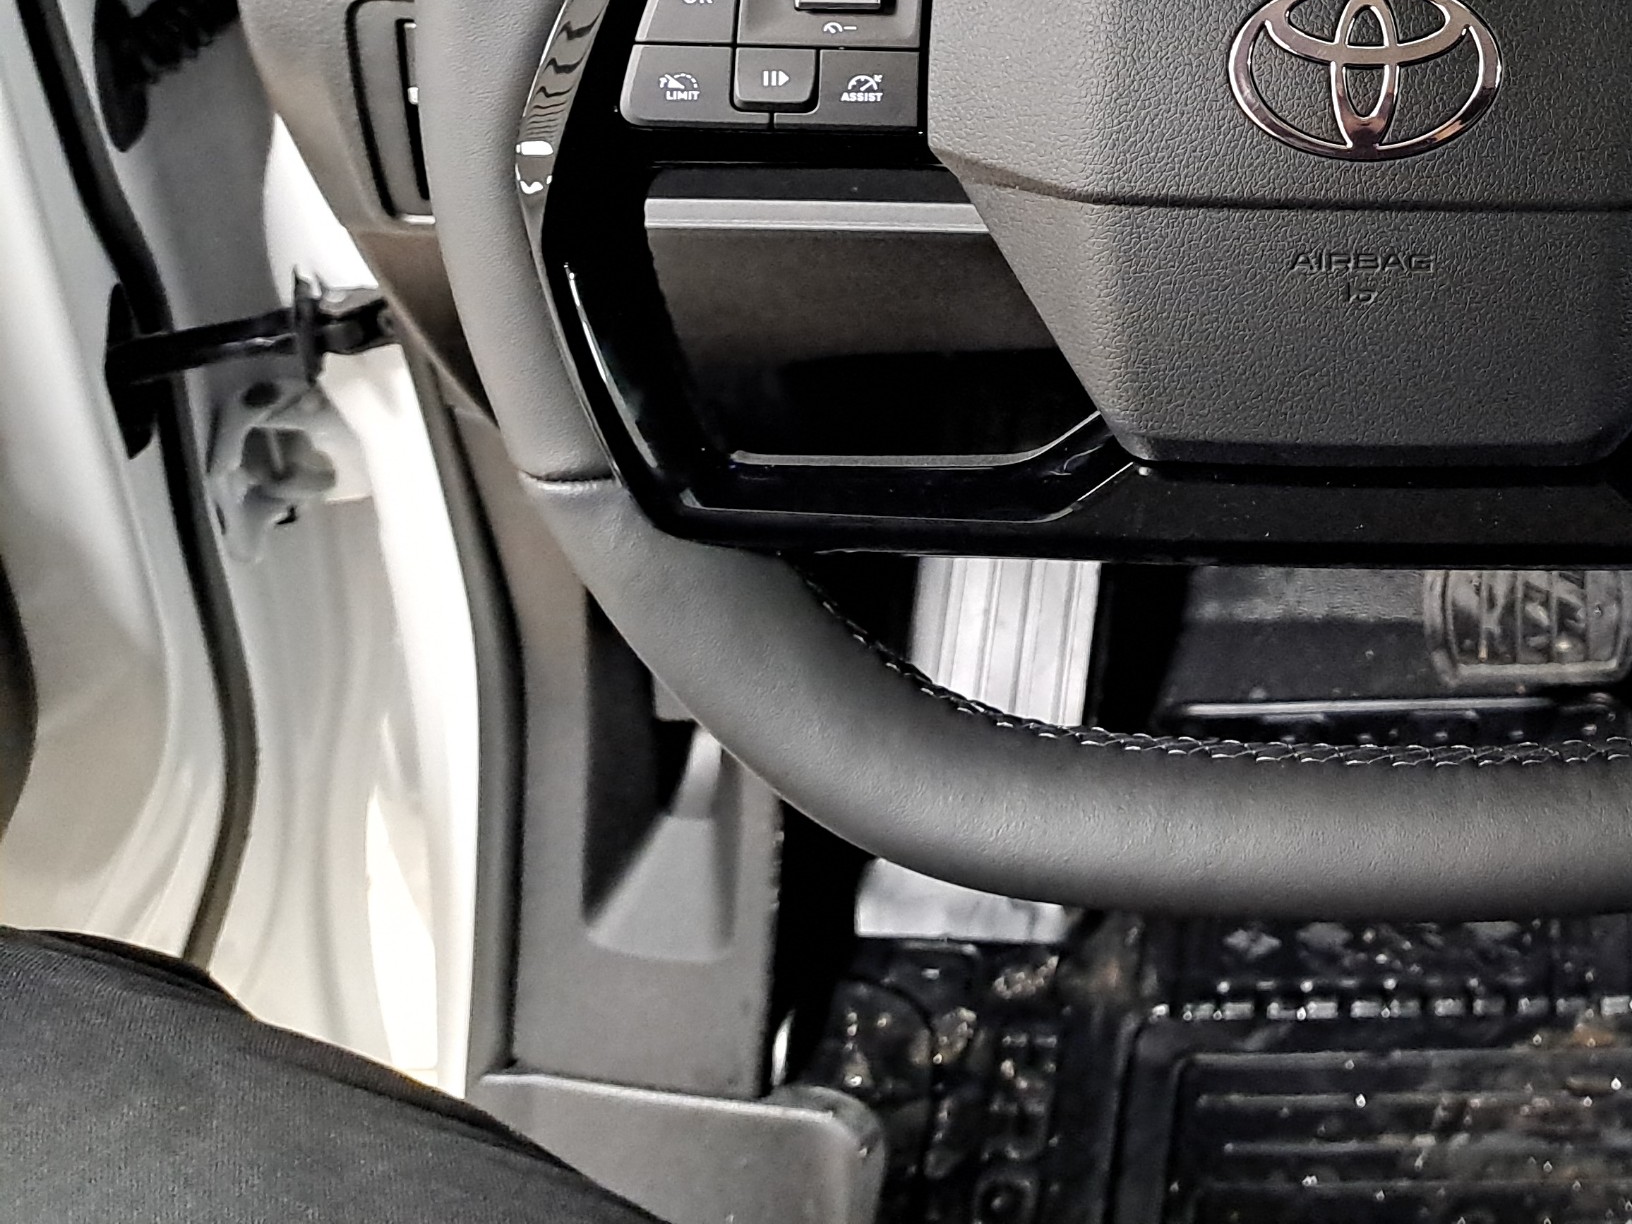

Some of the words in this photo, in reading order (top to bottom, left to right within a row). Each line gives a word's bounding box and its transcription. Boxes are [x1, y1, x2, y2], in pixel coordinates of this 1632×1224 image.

[665, 89, 701, 102] LIMIT
[840, 90, 884, 103] ASSIST
[1290, 251, 1438, 274] AIRBAG
